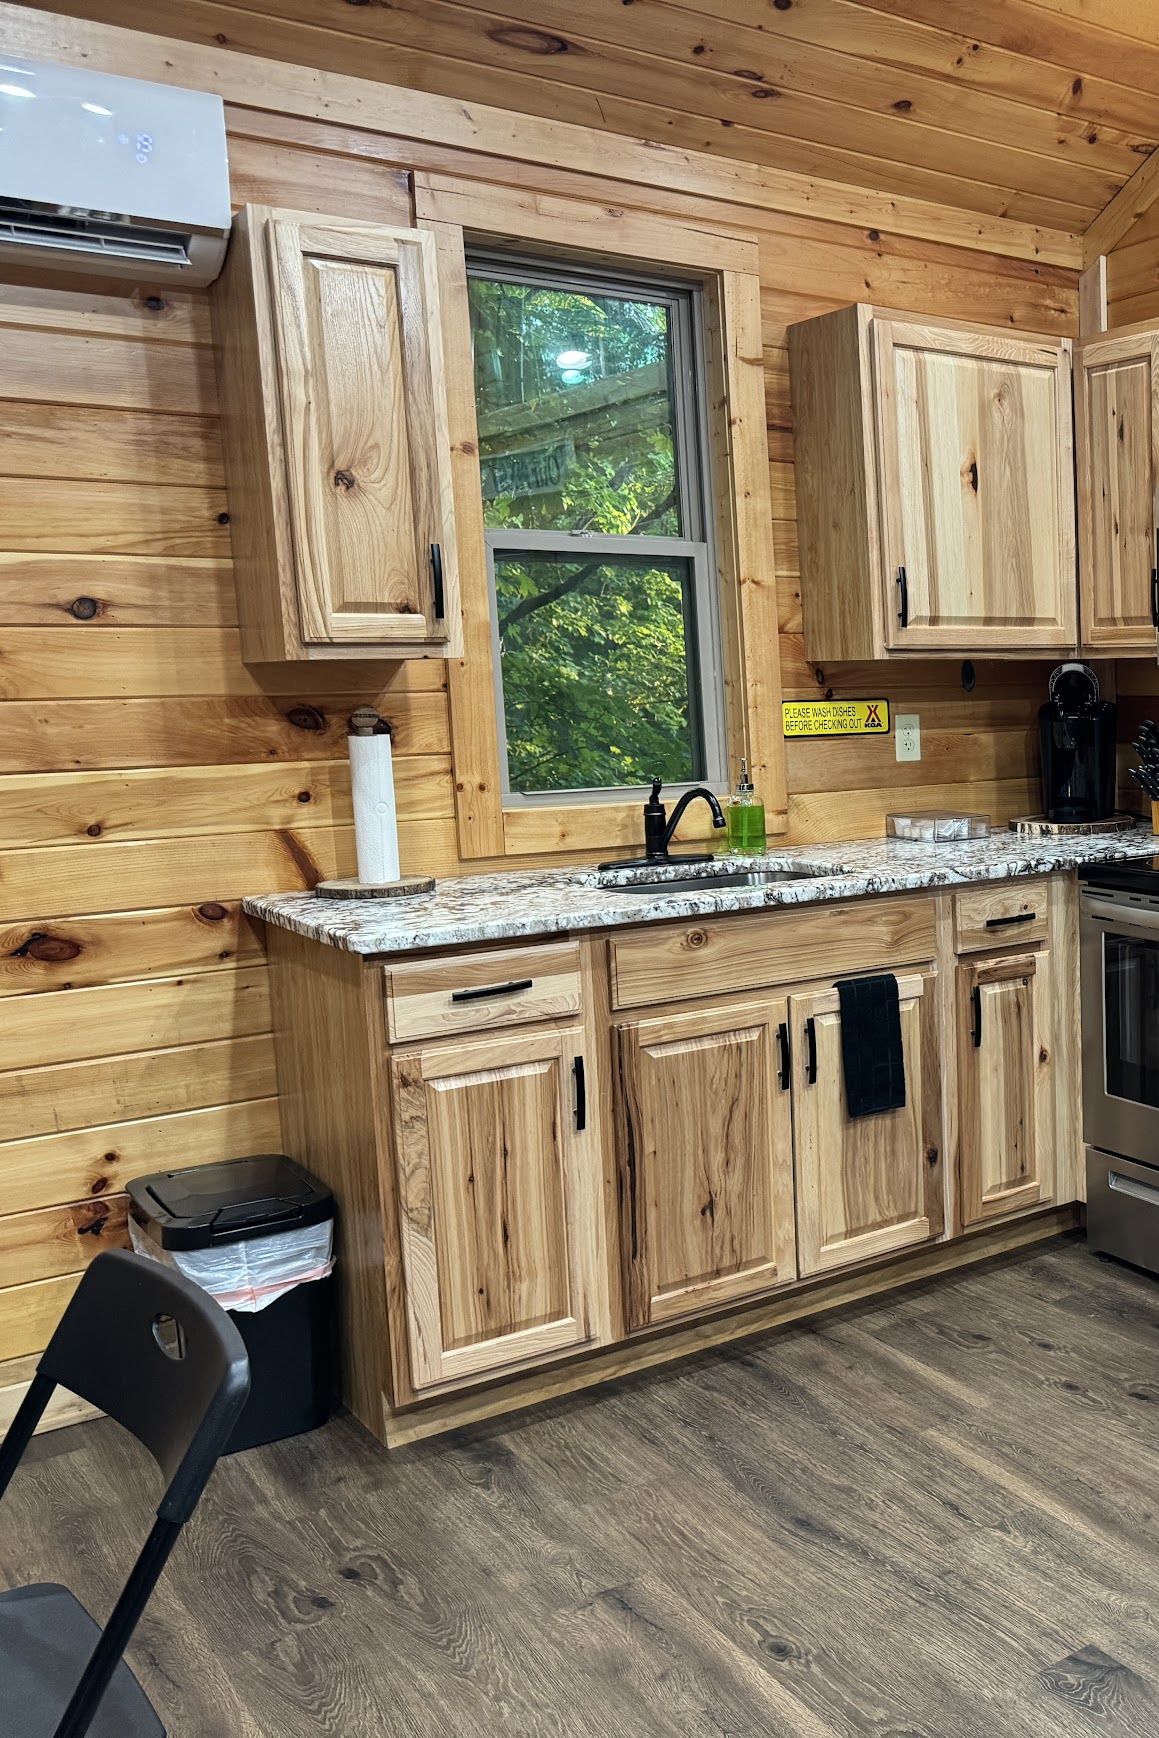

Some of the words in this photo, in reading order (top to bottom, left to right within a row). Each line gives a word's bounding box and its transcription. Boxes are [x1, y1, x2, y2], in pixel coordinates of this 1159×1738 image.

[785, 707, 811, 718] PLEASE
[812, 706, 831, 718] WASH
[833, 706, 856, 717] DISHES
[786, 720, 813, 731] BEFORE
[814, 718, 848, 730] CHECKING
[849, 718, 862, 729] OUT
